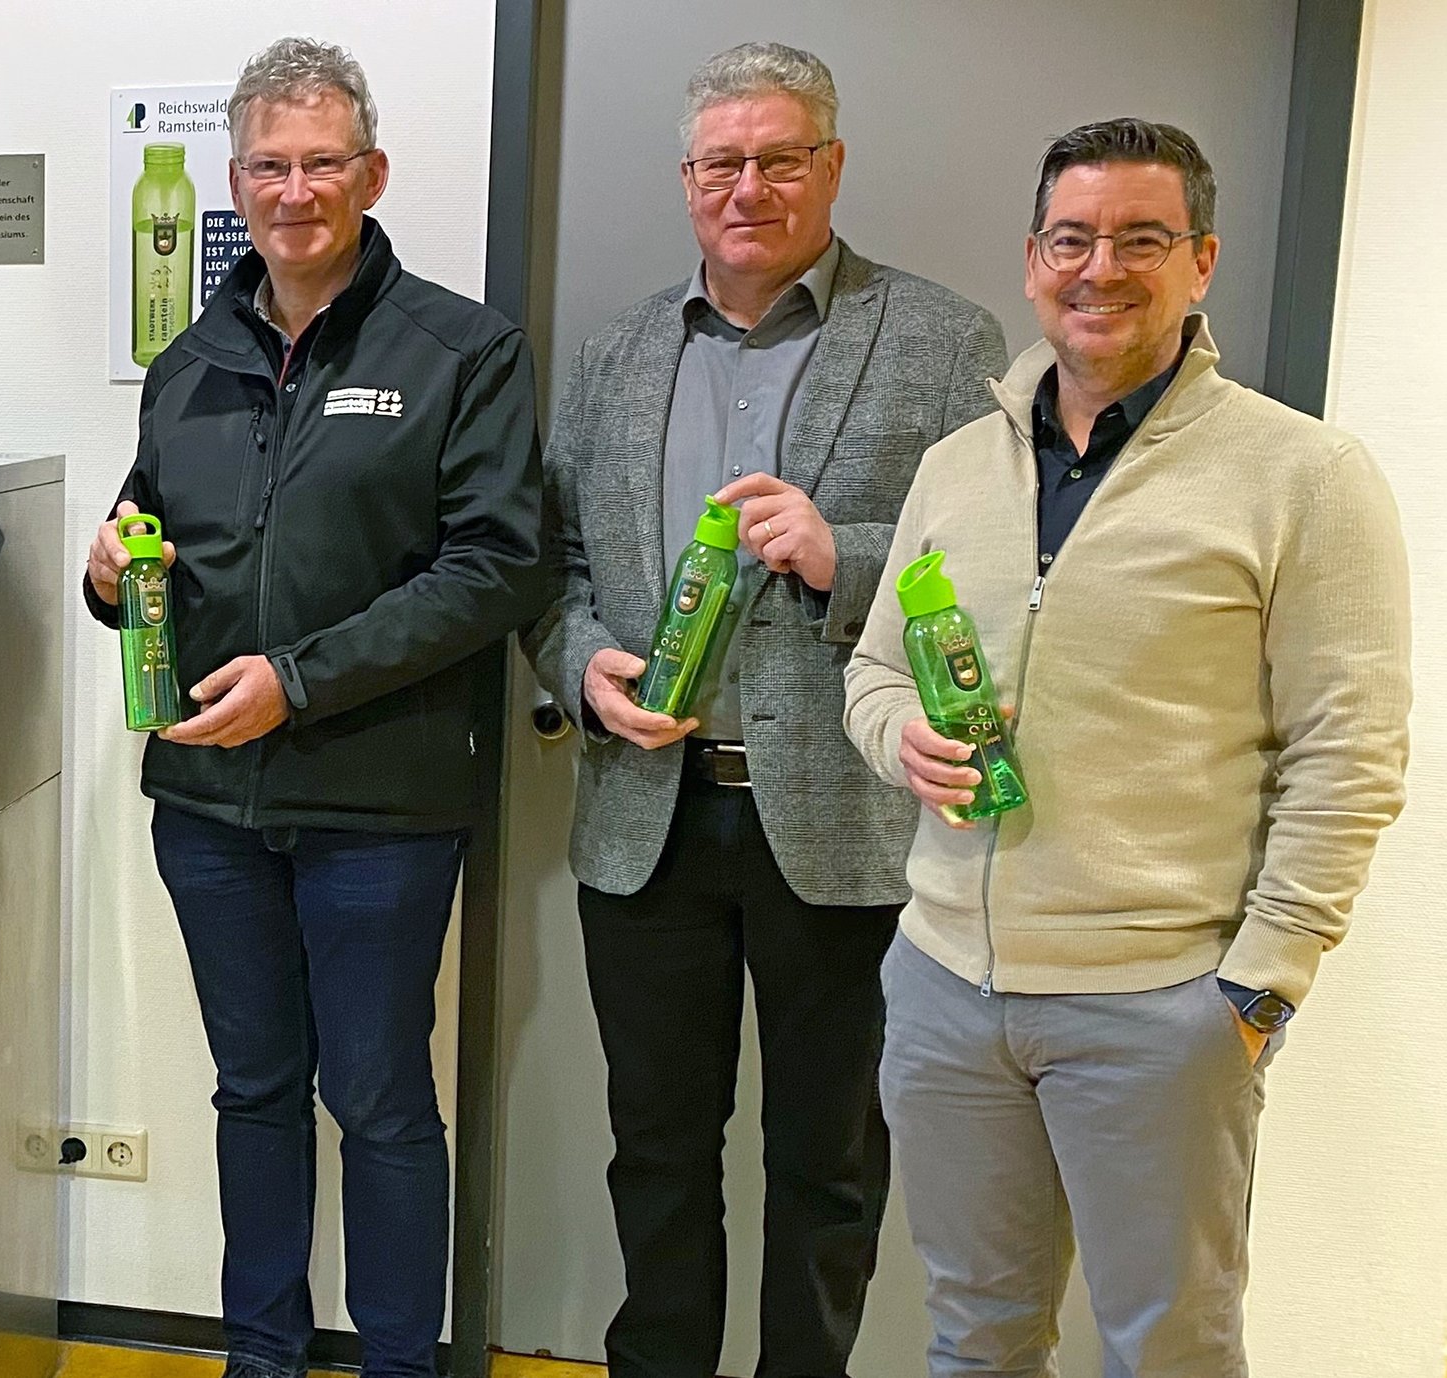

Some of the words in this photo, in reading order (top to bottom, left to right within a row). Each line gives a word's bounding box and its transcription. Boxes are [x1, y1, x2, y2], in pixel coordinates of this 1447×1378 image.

[158, 99, 228, 115] Reichswald
[206, 217, 225, 228] DIE
[206, 231, 251, 242] WASSER
[205, 246, 225, 257] IST
[205, 261, 230, 271] LICH
[159, 298, 168, 342] ramstein
